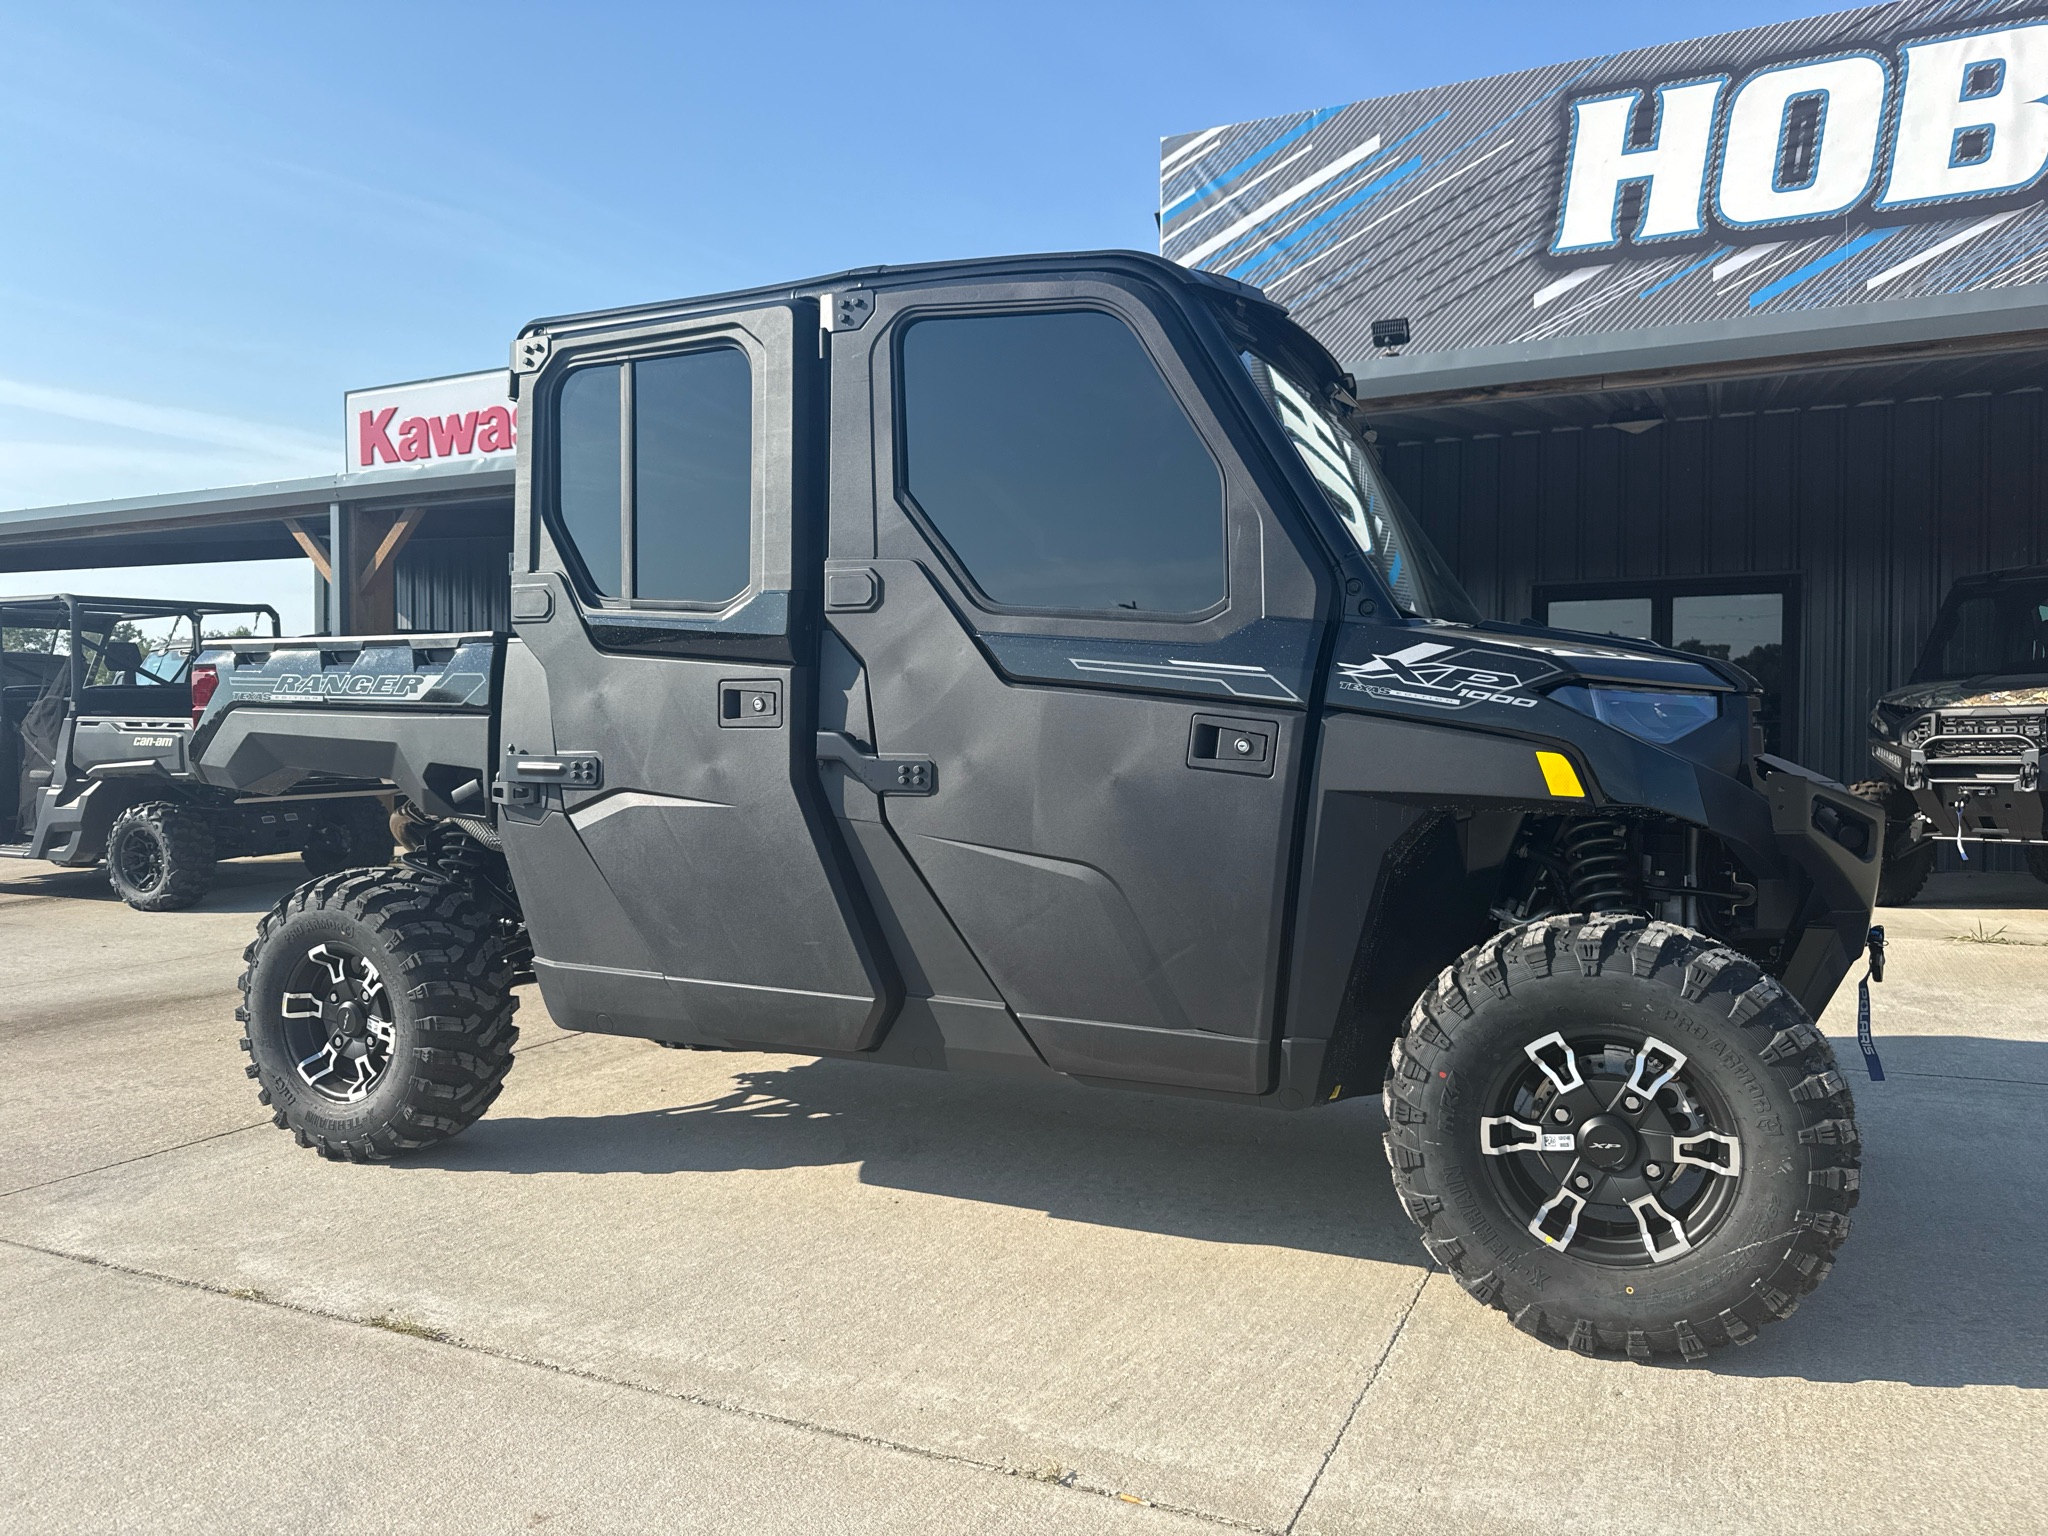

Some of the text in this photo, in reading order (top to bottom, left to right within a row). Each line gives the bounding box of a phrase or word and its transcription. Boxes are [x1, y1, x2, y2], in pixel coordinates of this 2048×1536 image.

[1550, 21, 2048, 253] HOB
[359, 405, 518, 466] Kawa
[273, 674, 425, 695] RANGER
[1339, 681, 1392, 696] TEXAS
[232, 691, 272, 701] TEXAS
[1457, 688, 1538, 708] 1000
[1942, 725, 2041, 736] POLARIS
[133, 736, 173, 747] can-am
[1859, 987, 1876, 1056] POLARIS
[1661, 1008, 1773, 1114] PRO ARMOR
[1588, 1142, 1622, 1150] XP
[1443, 1163, 1552, 1292] X-TERRAIN
